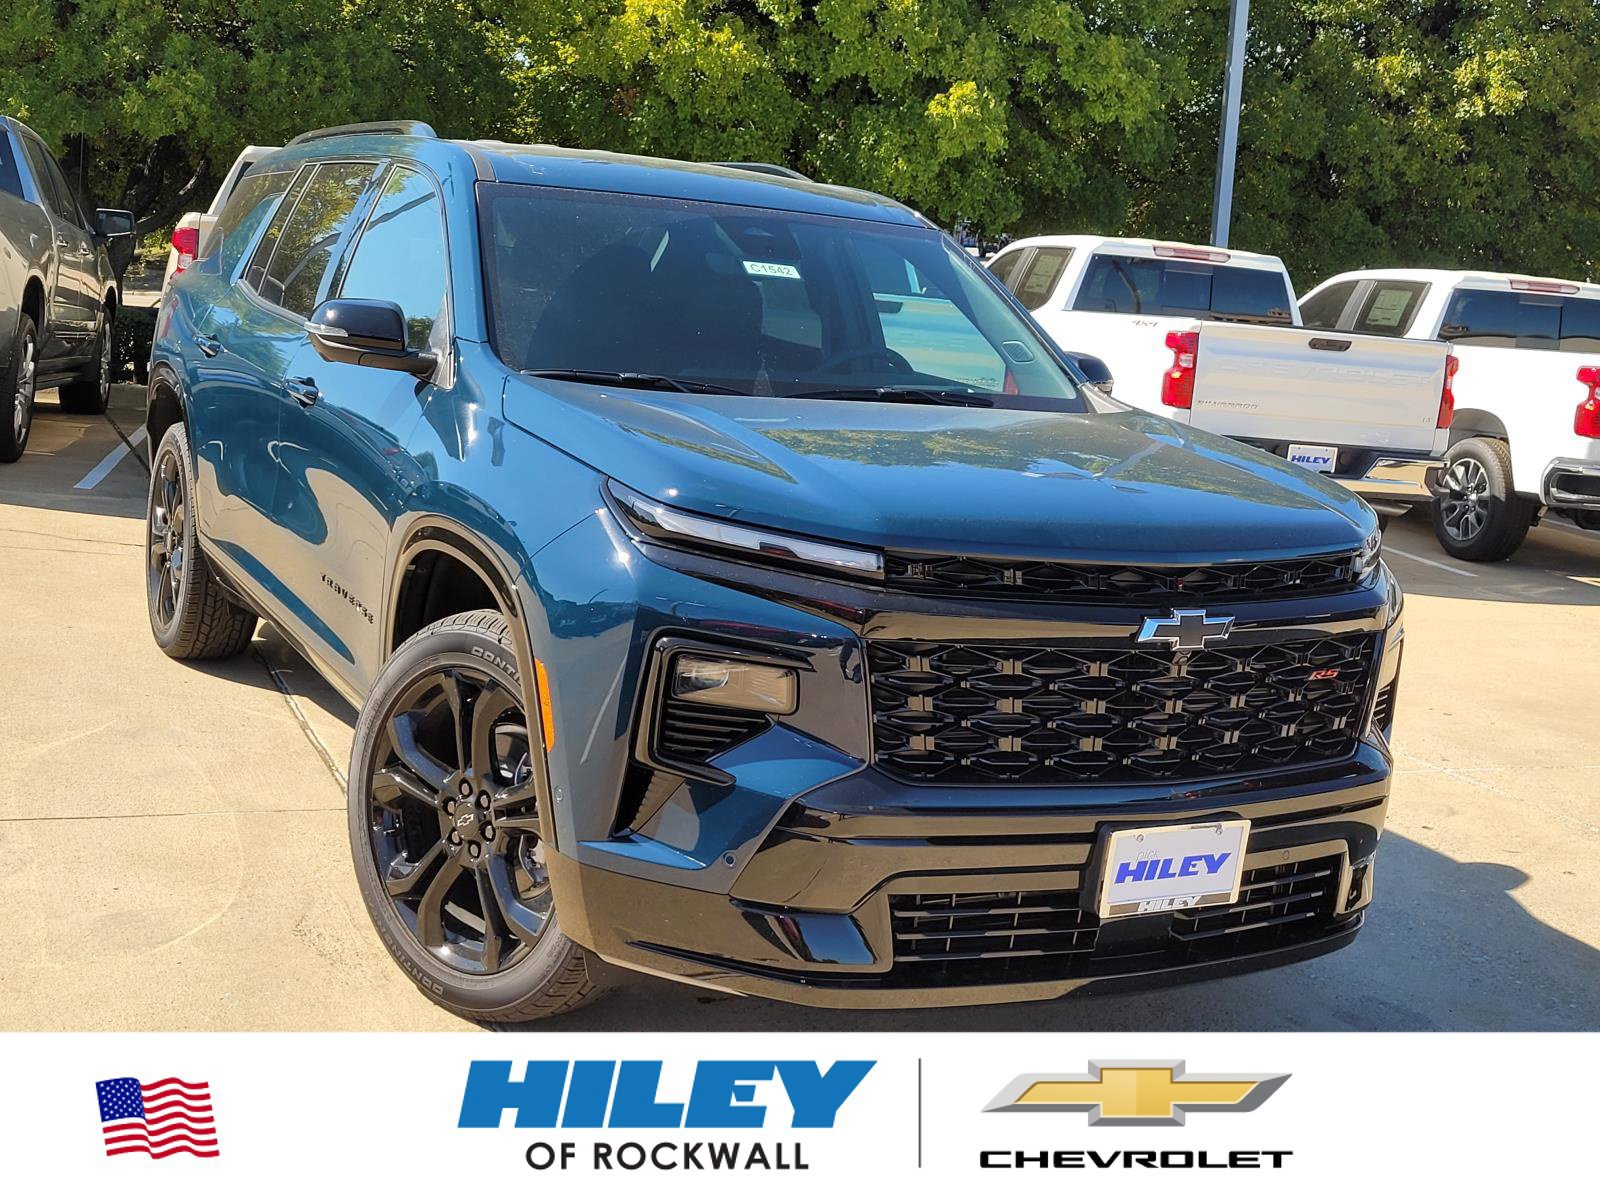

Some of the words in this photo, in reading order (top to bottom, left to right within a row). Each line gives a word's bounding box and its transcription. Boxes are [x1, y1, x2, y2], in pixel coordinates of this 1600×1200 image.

[750, 263, 794, 276] C1542
[1291, 454, 1331, 465] HILEY
[320, 572, 374, 624] TRAVERSE
[1309, 668, 1339, 680] RS
[1114, 852, 1232, 885] HILEY
[1137, 895, 1202, 913] HILEY
